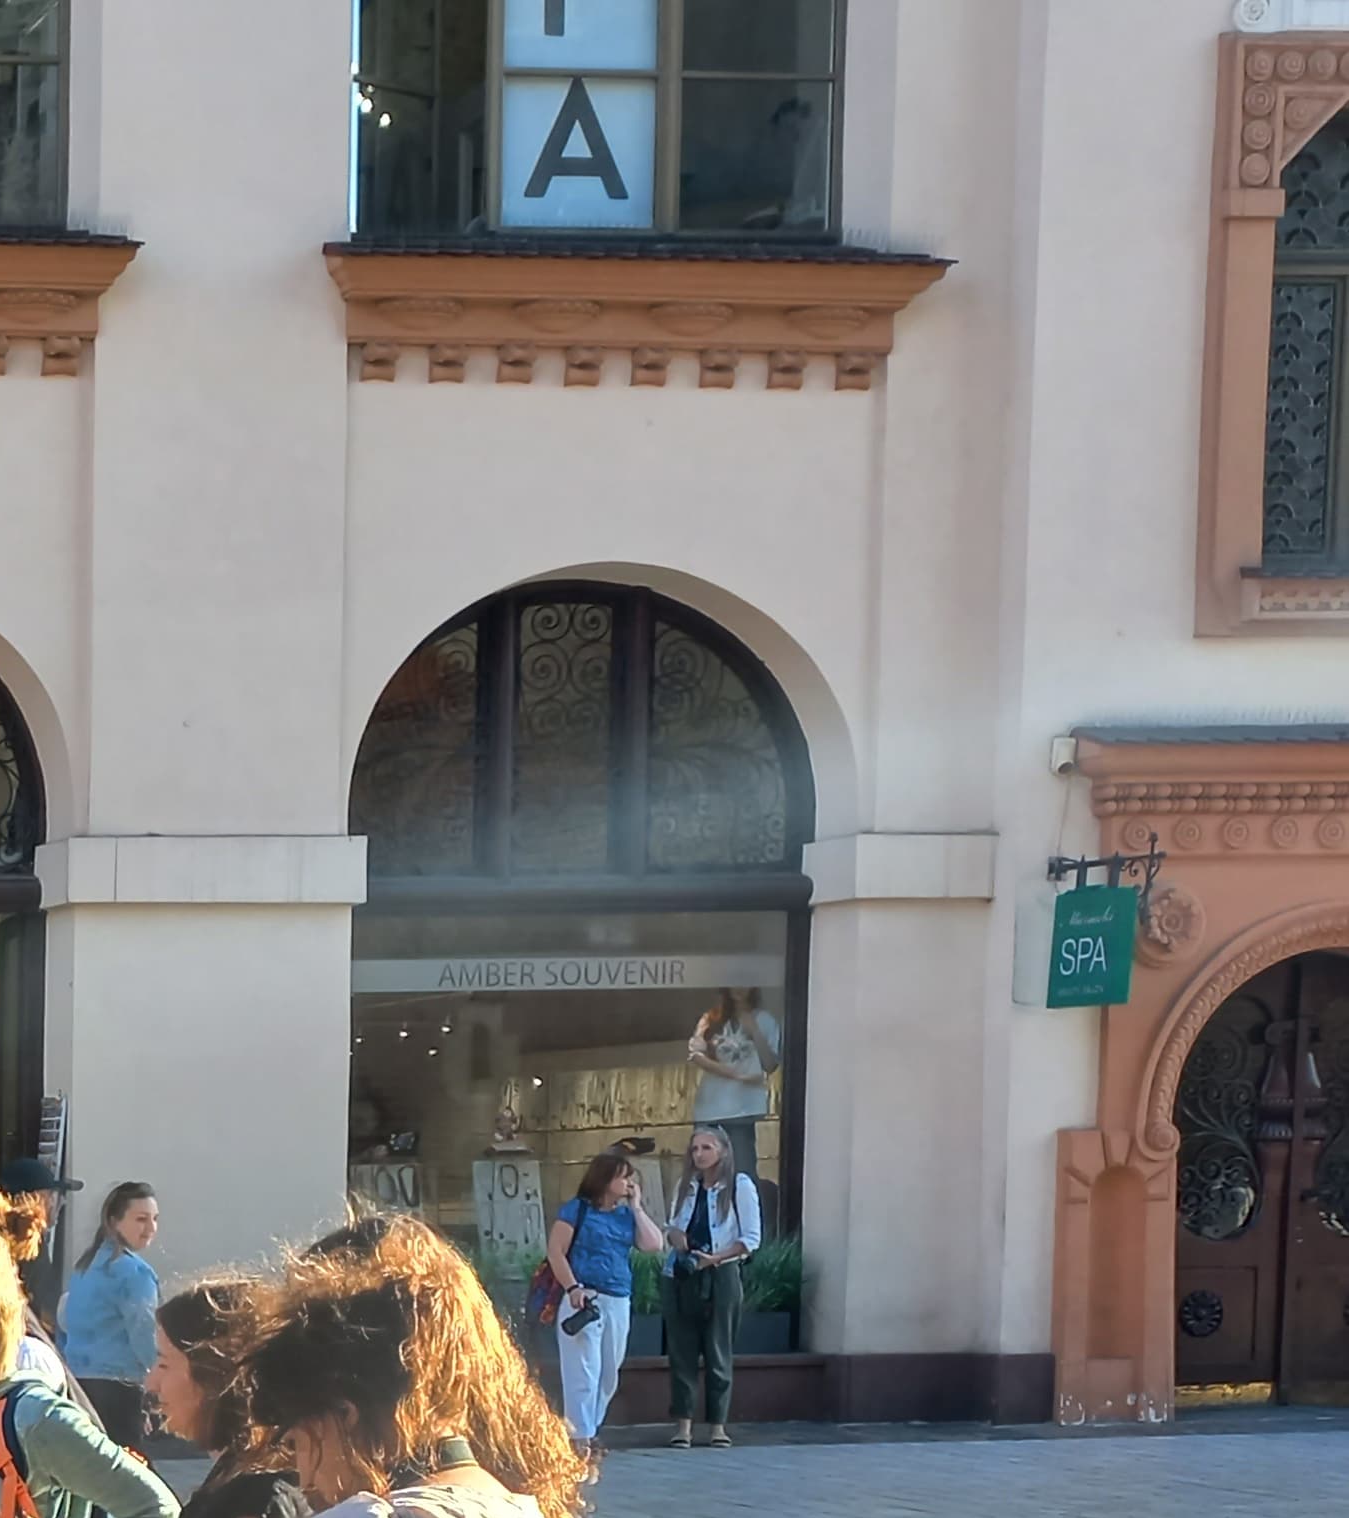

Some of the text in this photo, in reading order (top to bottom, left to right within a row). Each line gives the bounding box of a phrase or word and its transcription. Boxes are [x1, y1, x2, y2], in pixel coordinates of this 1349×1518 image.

[1059, 936, 1107, 976] SPA
[438, 959, 686, 988] AMBER SOUVENIR
